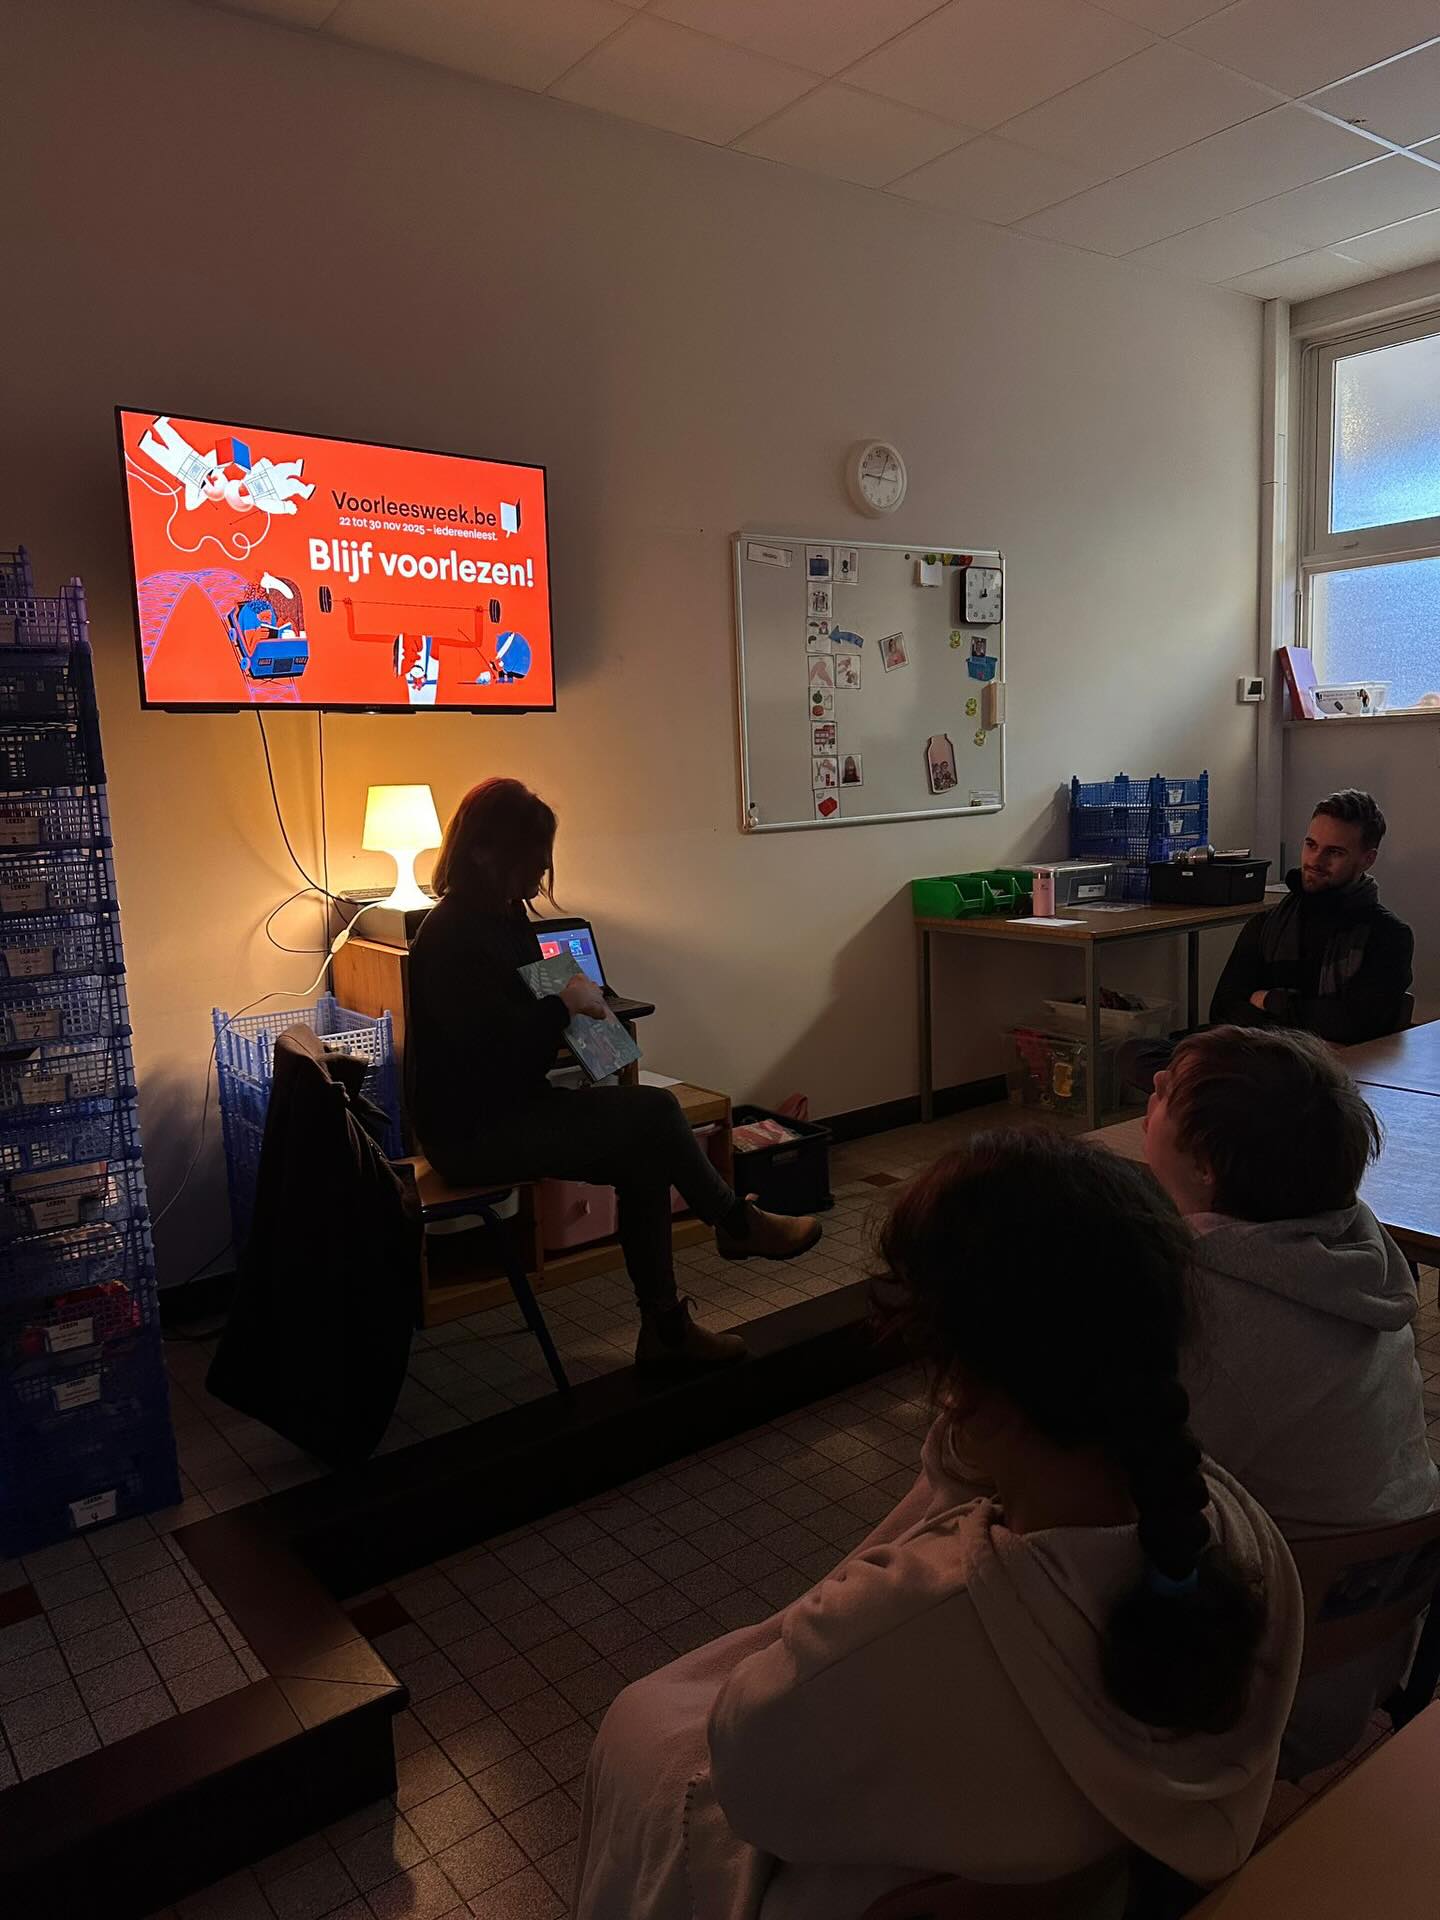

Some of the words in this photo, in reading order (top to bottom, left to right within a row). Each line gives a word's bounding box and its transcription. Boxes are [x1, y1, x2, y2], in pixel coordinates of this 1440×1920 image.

[331, 490, 497, 527] Voorleesweek.be
[339, 516, 351, 526] 22
[352, 517, 368, 528] tot
[369, 519, 382, 530] 30
[383, 521, 401, 531] nov
[402, 523, 425, 535] 2025
[433, 524, 499, 541] iedereenleest.
[308, 538, 373, 583] Blijf
[378, 549, 535, 588] voorlezen!
[32, 1024, 41, 1037] 2
